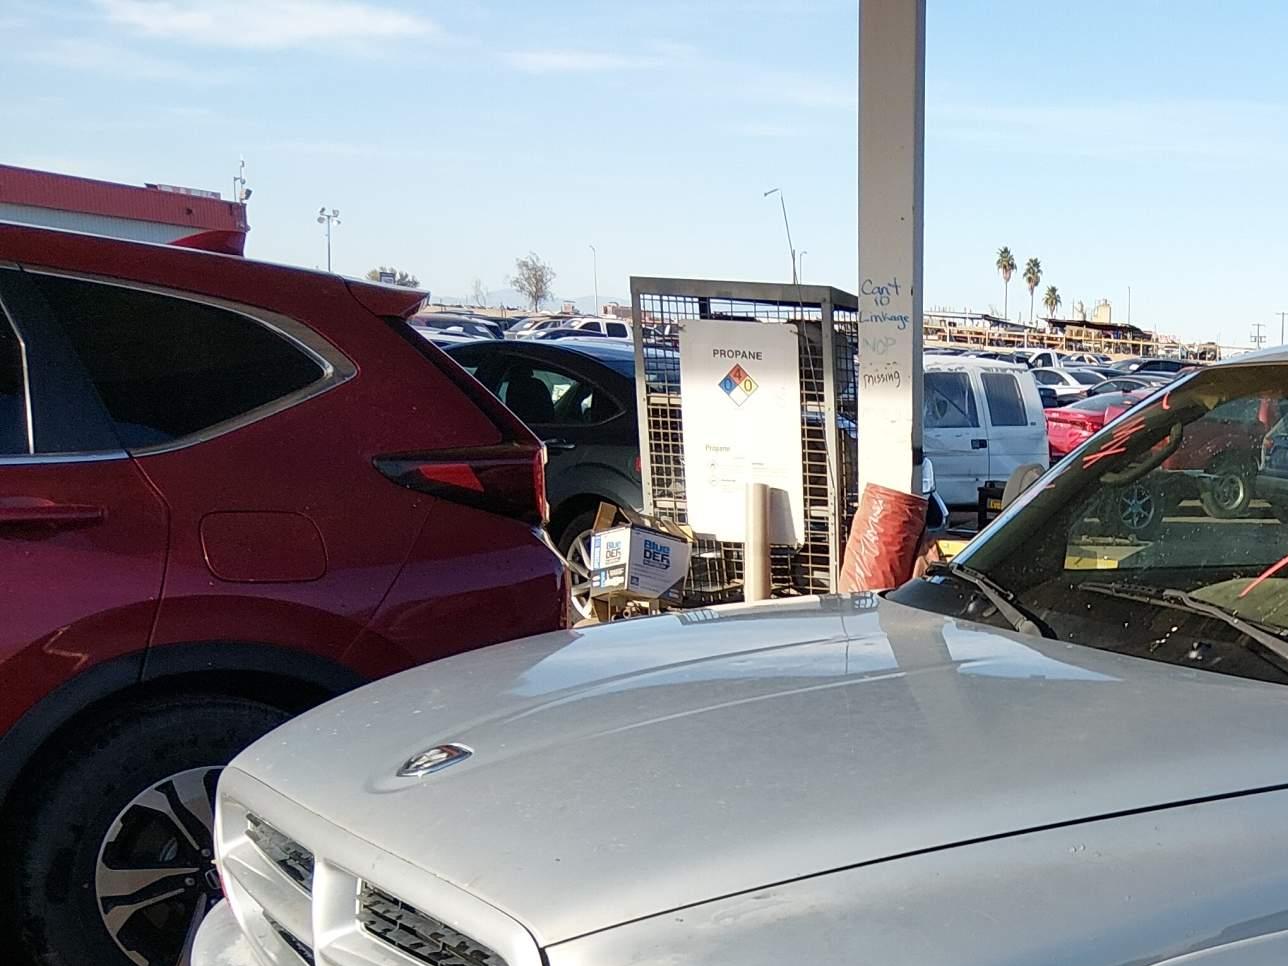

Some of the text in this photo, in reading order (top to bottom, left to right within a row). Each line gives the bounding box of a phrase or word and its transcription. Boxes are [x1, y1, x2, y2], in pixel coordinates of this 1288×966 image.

[712, 349, 763, 360] PROPANE
[733, 369, 742, 380] 4
[863, 370, 900, 388] missing
[743, 379, 753, 392] 0
[643, 539, 671, 554] Blue
